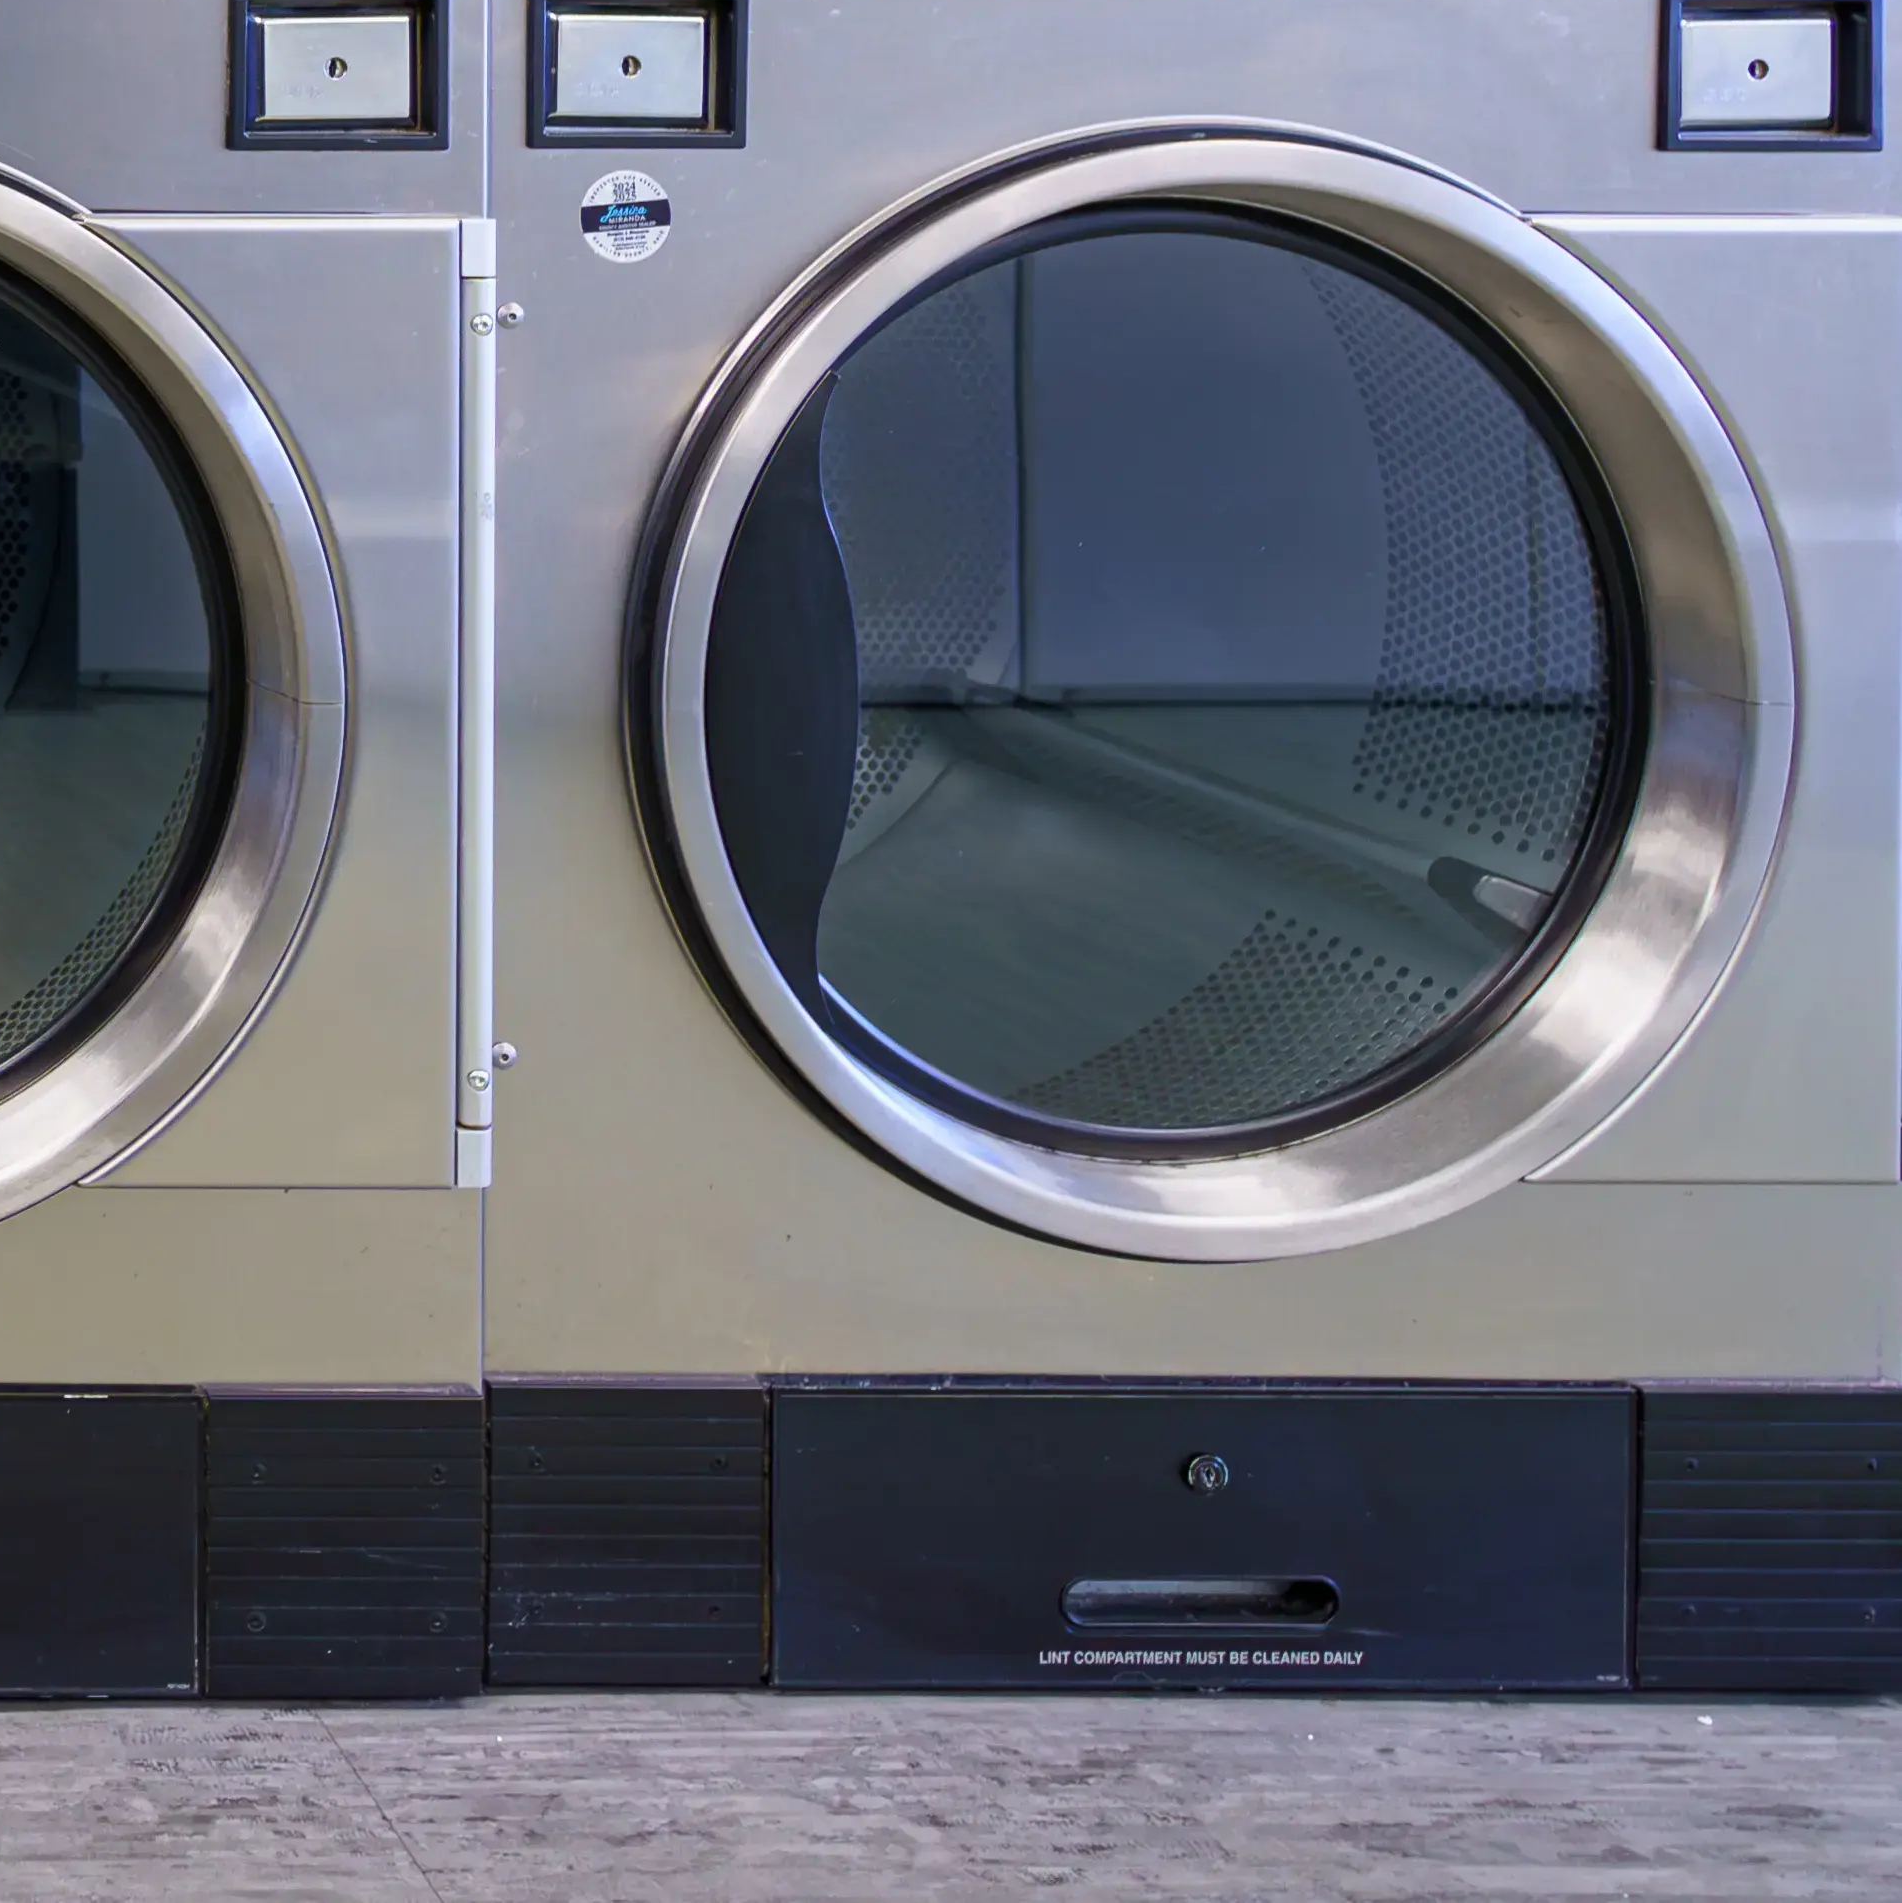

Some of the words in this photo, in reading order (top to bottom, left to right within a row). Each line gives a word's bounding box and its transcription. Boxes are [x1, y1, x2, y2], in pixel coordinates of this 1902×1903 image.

[1040, 1651, 1070, 1664] LINT
[1074, 1651, 1182, 1664] COMPARTMENT
[1186, 1652, 1225, 1664] MUST
[1230, 1652, 1248, 1664] BE
[1253, 1652, 1320, 1664] CLEANED
[1324, 1652, 1363, 1664] DAILY
